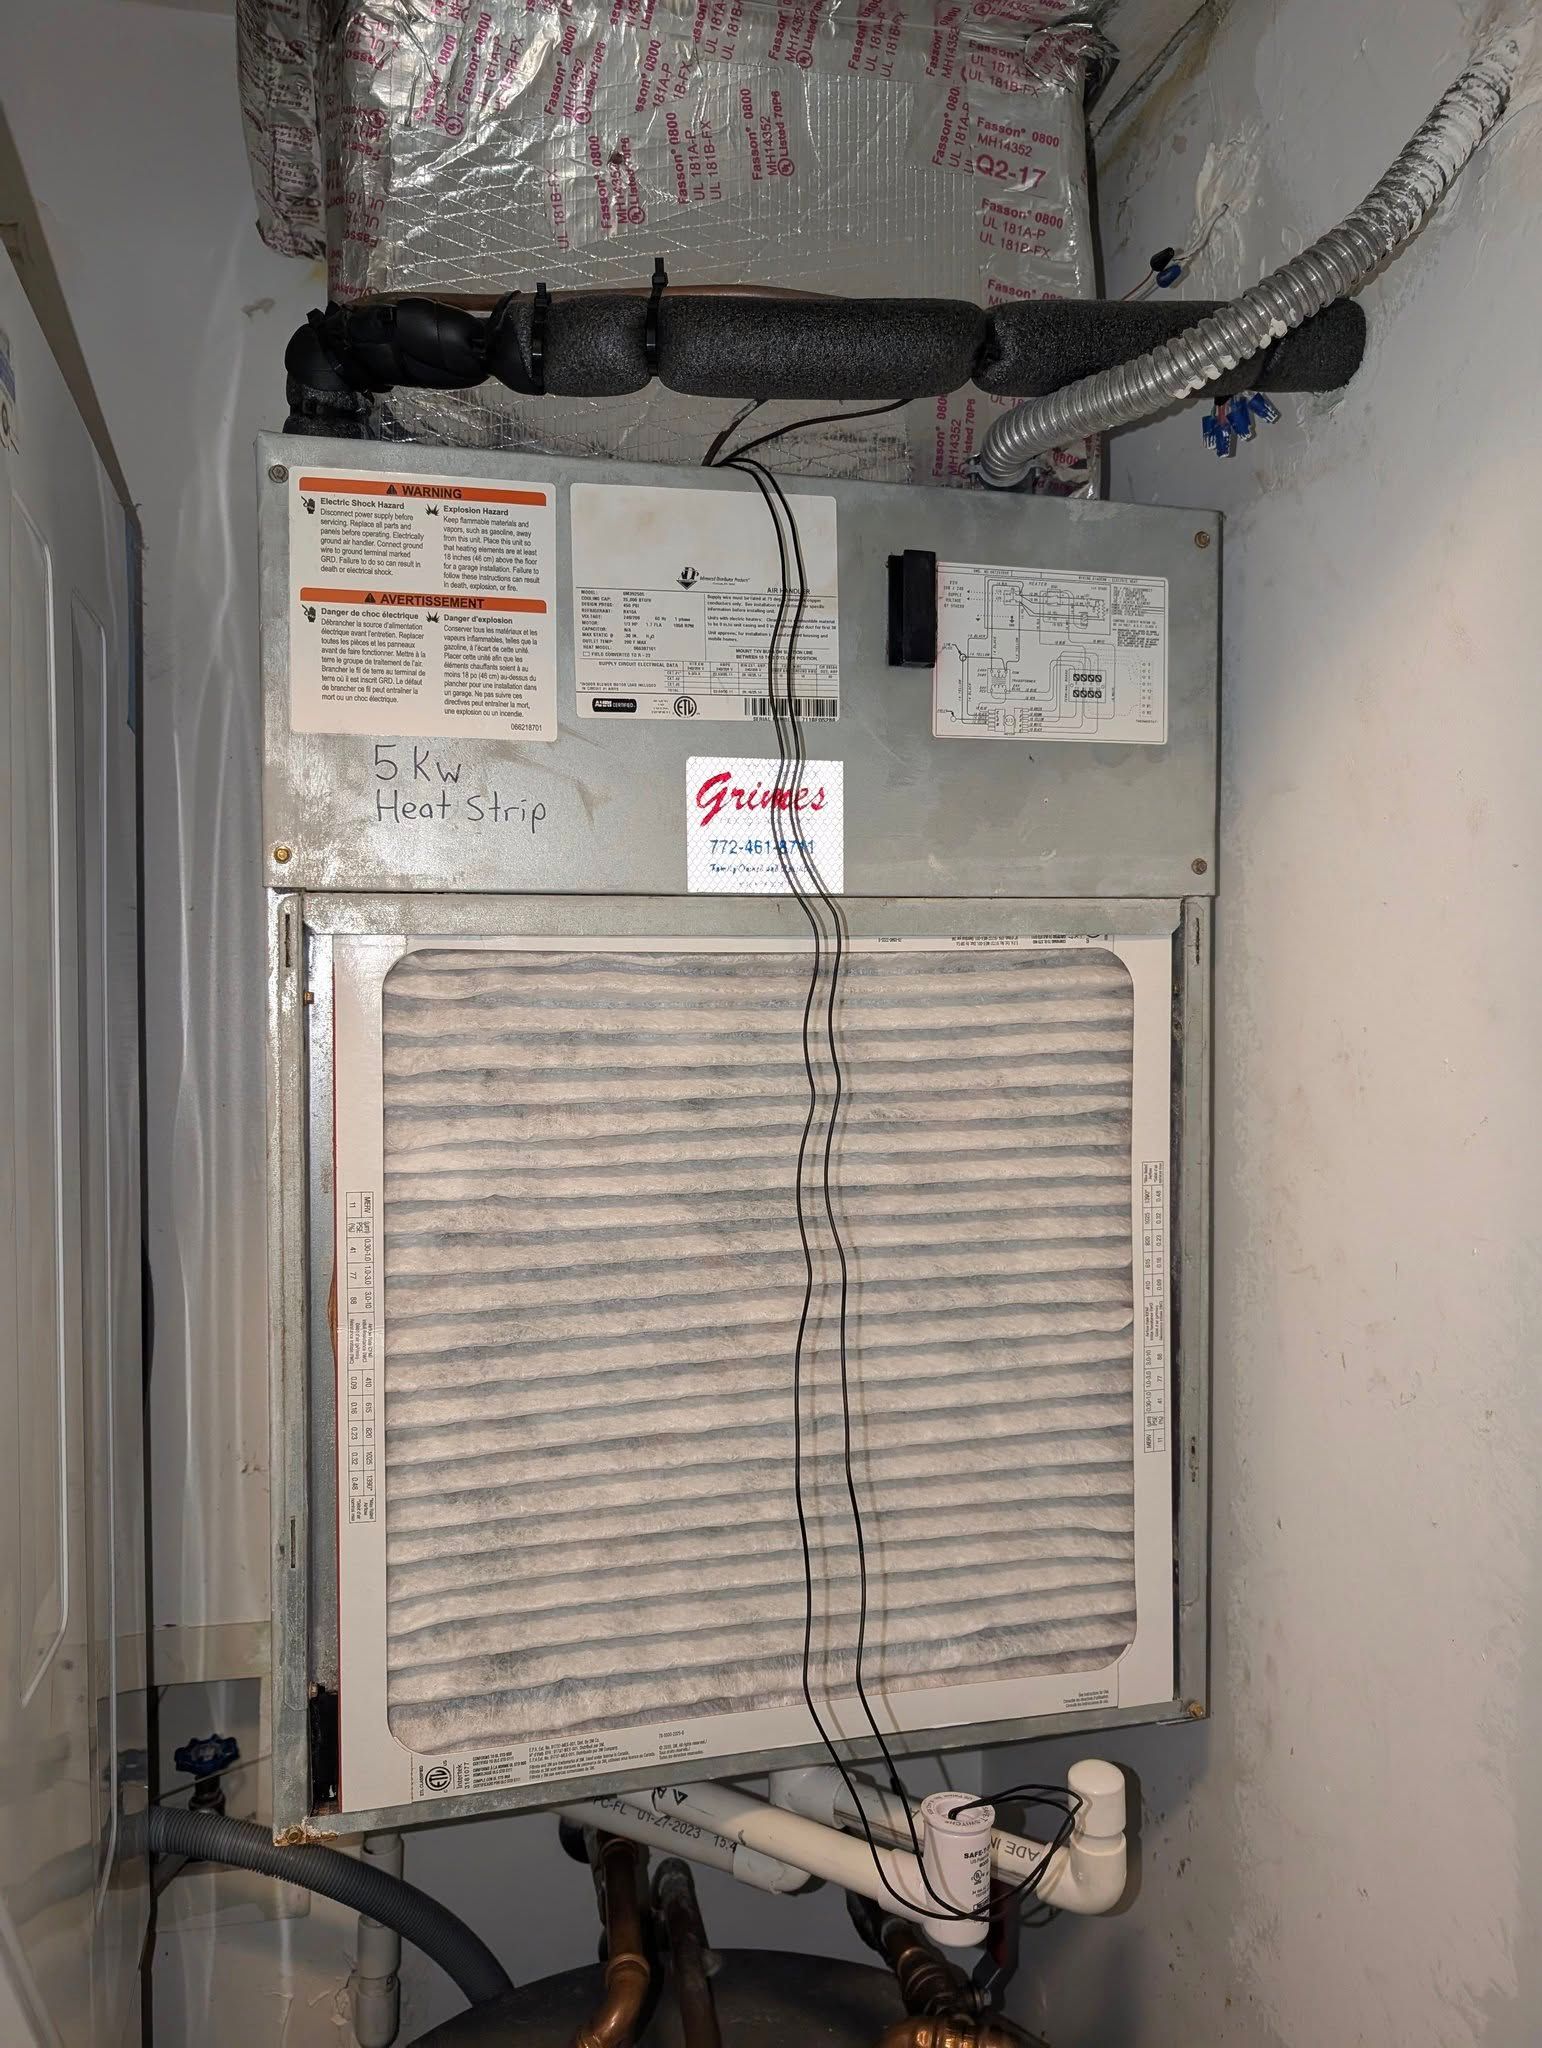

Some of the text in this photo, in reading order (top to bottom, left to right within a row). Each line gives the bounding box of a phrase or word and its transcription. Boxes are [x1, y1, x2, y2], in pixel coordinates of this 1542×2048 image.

[474, 12, 492, 46] 0800
[560, 25, 577, 56] 0800
[437, 34, 457, 66] 0800
[644, 39, 662, 72] 0800
[971, 53, 986, 67] UL
[740, 88, 754, 120] 0800
[666, 112, 681, 145] 0800
[771, 90, 790, 157] Listed 70P6
[760, 115, 779, 177] MH14352
[977, 133, 1033, 158] MH14352
[1032, 131, 1060, 148] 0800
[588, 135, 603, 167] 0800
[700, 119, 722, 200] UL 181B-FX
[948, 151, 963, 168] UL
[685, 129, 706, 201] UL 181A-P
[976, 153, 1047, 188] Q2-17
[982, 215, 1047, 240] UL 181A-P
[1034, 212, 1064, 230] 0800
[557, 232, 570, 250] UL
[979, 231, 1051, 259] UL 181B-FX
[402, 485, 461, 498] WARNING
[320, 497, 405, 509] Electric Shock Hazard
[443, 505, 508, 516] Explosion Hazard
[320, 508, 353, 516] Disconnect
[374, 512, 393, 520] supply
[442, 516, 458, 524] Keep
[460, 517, 489, 525] flammable
[490, 519, 516, 527] materials
[320, 518, 346, 527] servicing.
[349, 520, 374, 528] Replace
[383, 522, 398, 530] parts
[443, 526, 464, 534] vapors,
[466, 526, 479, 534] such
[489, 528, 513, 537] gasoline,
[320, 527, 424, 541] panels before operating. Electrically
[780, 587, 811, 595] HANDLR
[380, 593, 484, 609] AVERTISSEMENT
[320, 607, 348, 617] Danger
[361, 609, 380, 618] choc
[382, 610, 418, 621] électrique
[443, 613, 512, 626] Danger d'explosion
[320, 617, 354, 627] Débrancher
[383, 621, 422, 631] d'alimentation
[443, 624, 471, 632] Conserver
[495, 627, 522, 635] matériaux
[510, 722, 541, 732] 066218701
[375, 744, 398, 780] 5
[696, 771, 829, 827] Grimes
[377, 788, 546, 834] Heat Strip
[350, 1376, 358, 1390] 0.09
[365, 1376, 373, 1388] 410
[350, 1426, 358, 1440] 0.23
[365, 1427, 373, 1439] 820
